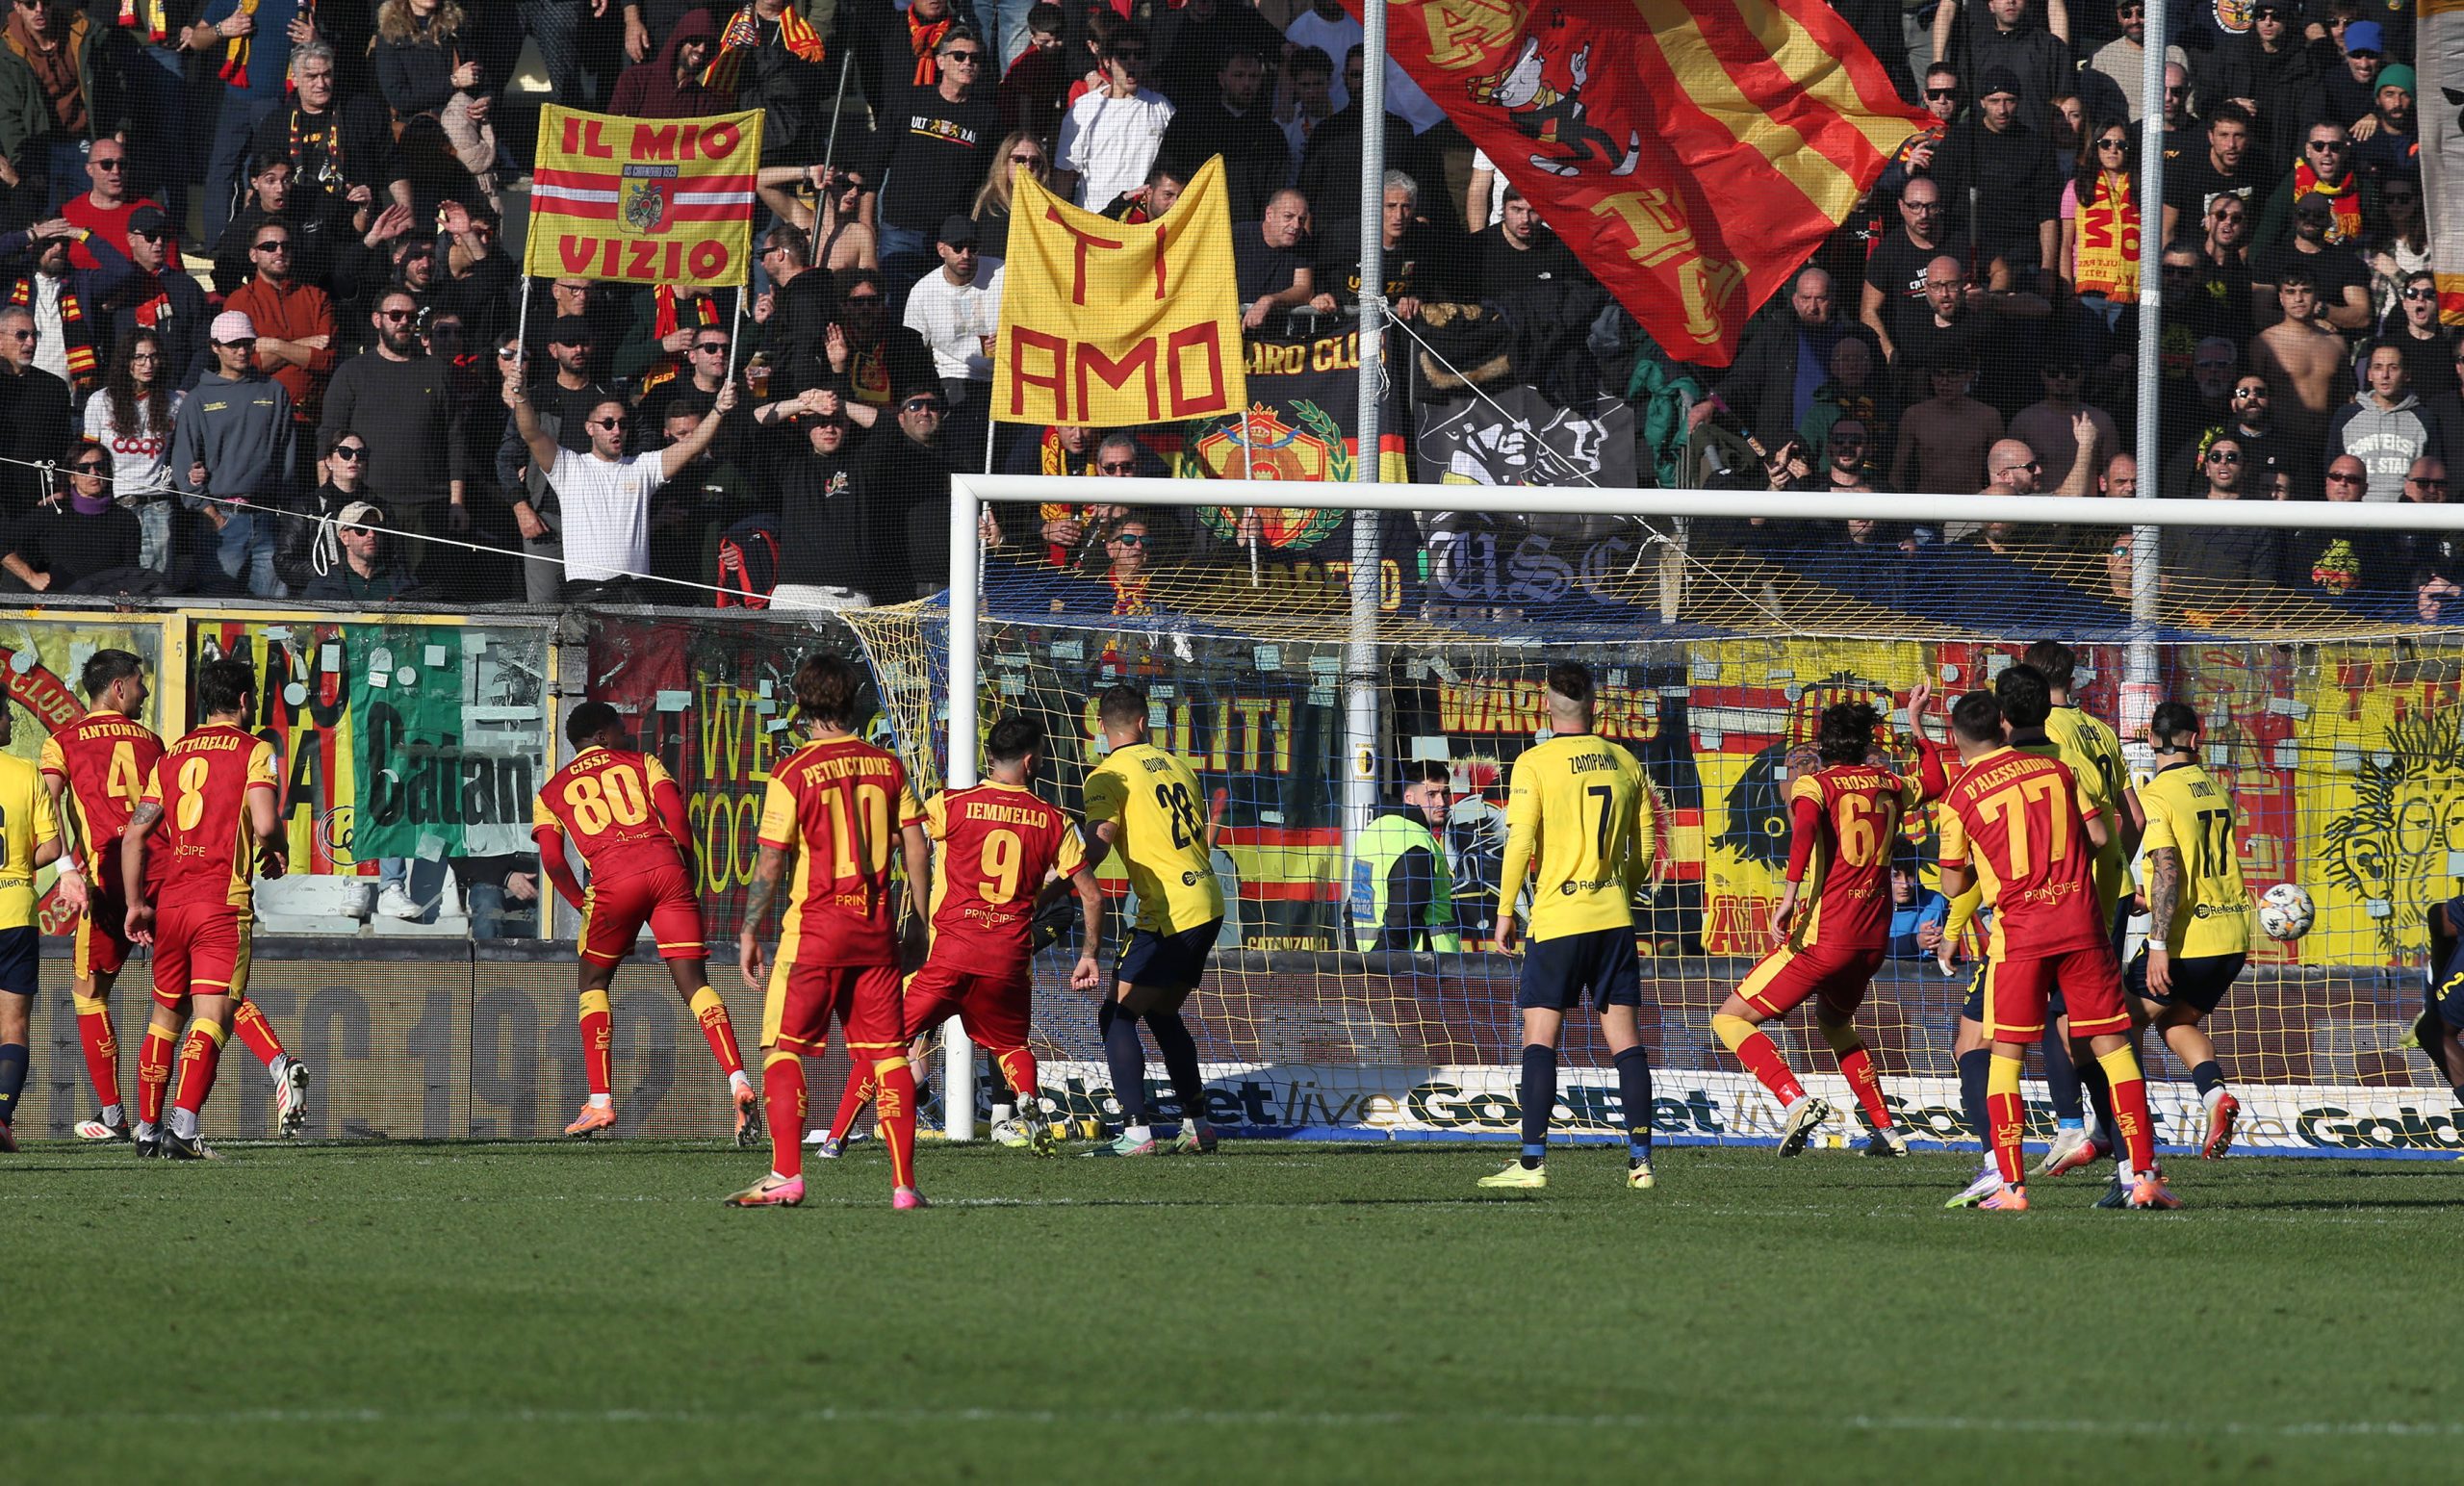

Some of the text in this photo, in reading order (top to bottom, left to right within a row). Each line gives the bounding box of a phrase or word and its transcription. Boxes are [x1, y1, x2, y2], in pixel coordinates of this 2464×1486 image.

[562, 116, 740, 161] IL MIO
[559, 235, 728, 280] VIZIO
[1045, 205, 1167, 306] TI
[1011, 320, 1226, 421] AMO
[1312, 332, 1386, 372] CLU
[113, 436, 166, 459] coop
[79, 724, 153, 741] ANTONINI
[167, 735, 240, 758] PITTARELLO
[107, 740, 143, 811] 4
[569, 754, 611, 776] CISSE
[801, 756, 893, 787] PETRICCIONE
[1568, 754, 1619, 775] ZAMPANO
[1964, 757, 2056, 800] D'ALESSANDRO
[176, 756, 209, 831] 8
[563, 764, 648, 835] 80
[965, 802, 1047, 829] IEMMELLO
[1155, 782, 1202, 850] 28
[820, 783, 888, 879] 10
[1588, 784, 1612, 859] 7
[1838, 792, 1896, 867] 62
[1976, 773, 2066, 880] 77
[979, 829, 1021, 904] 9
[2024, 881, 2081, 902] PRINCIPE
[964, 908, 1016, 923] PRINCIPE
[1282, 1080, 1399, 1128] live
